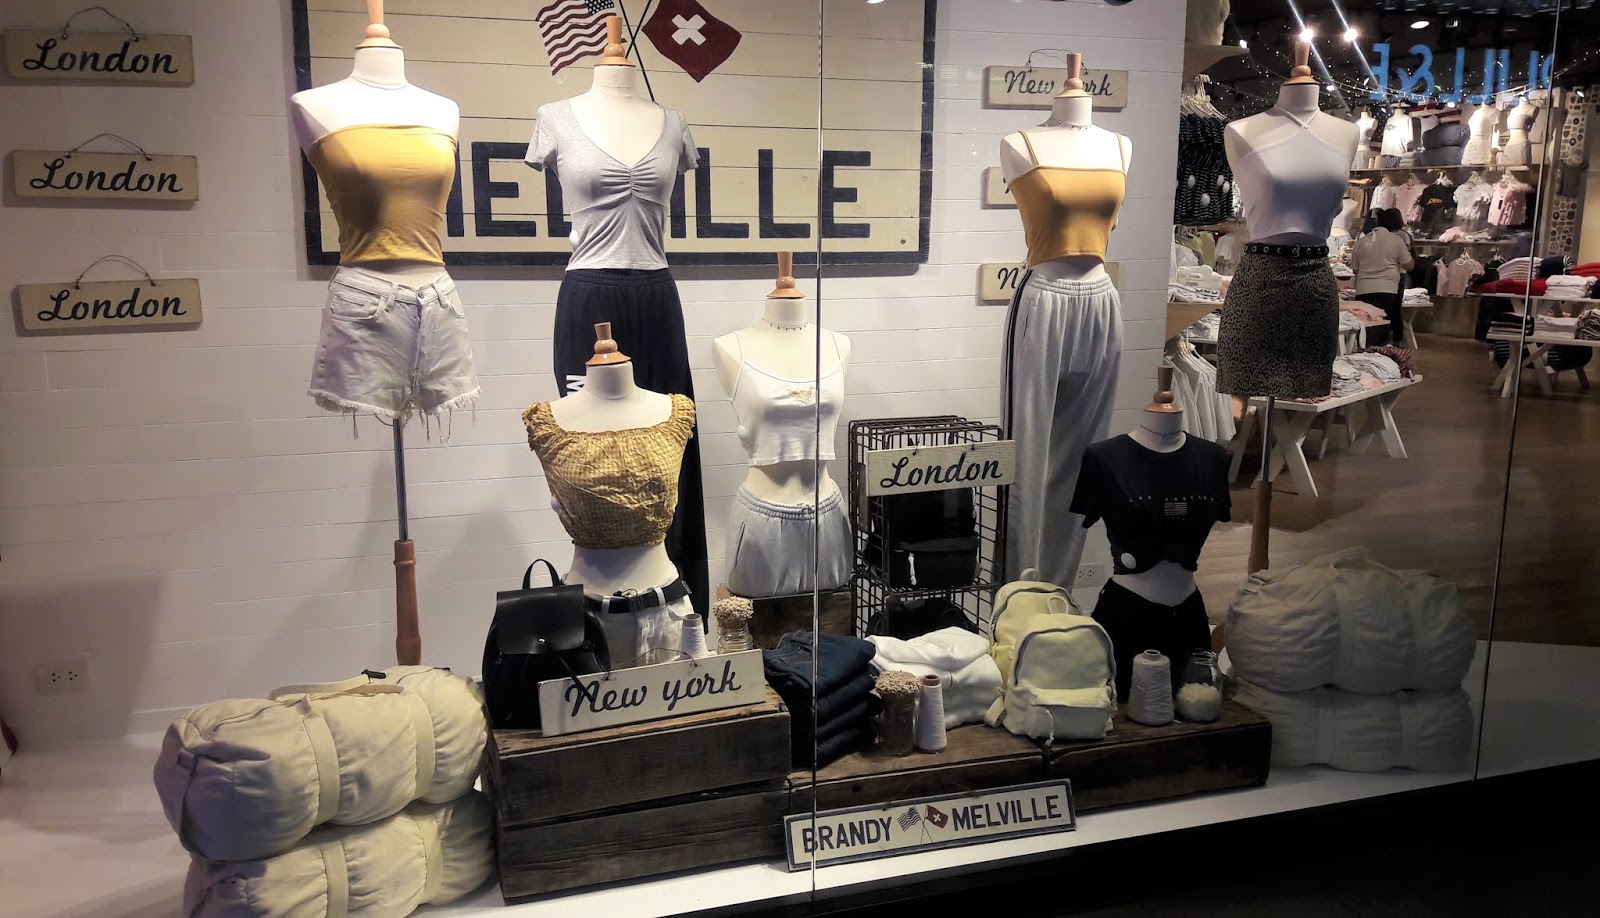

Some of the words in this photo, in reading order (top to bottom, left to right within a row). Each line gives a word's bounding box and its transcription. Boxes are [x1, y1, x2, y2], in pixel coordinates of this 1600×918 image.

[23, 38, 179, 74] London
[1004, 69, 1055, 95] New
[1082, 73, 1113, 97] ork
[29, 157, 183, 193] London
[445, 141, 872, 239] ELILLE
[37, 287, 187, 321] London
[879, 452, 1003, 489] London
[564, 680, 648, 717] New
[662, 659, 742, 711] york
[801, 816, 892, 853] BRANDY
[952, 794, 1062, 832] MELVILLE
